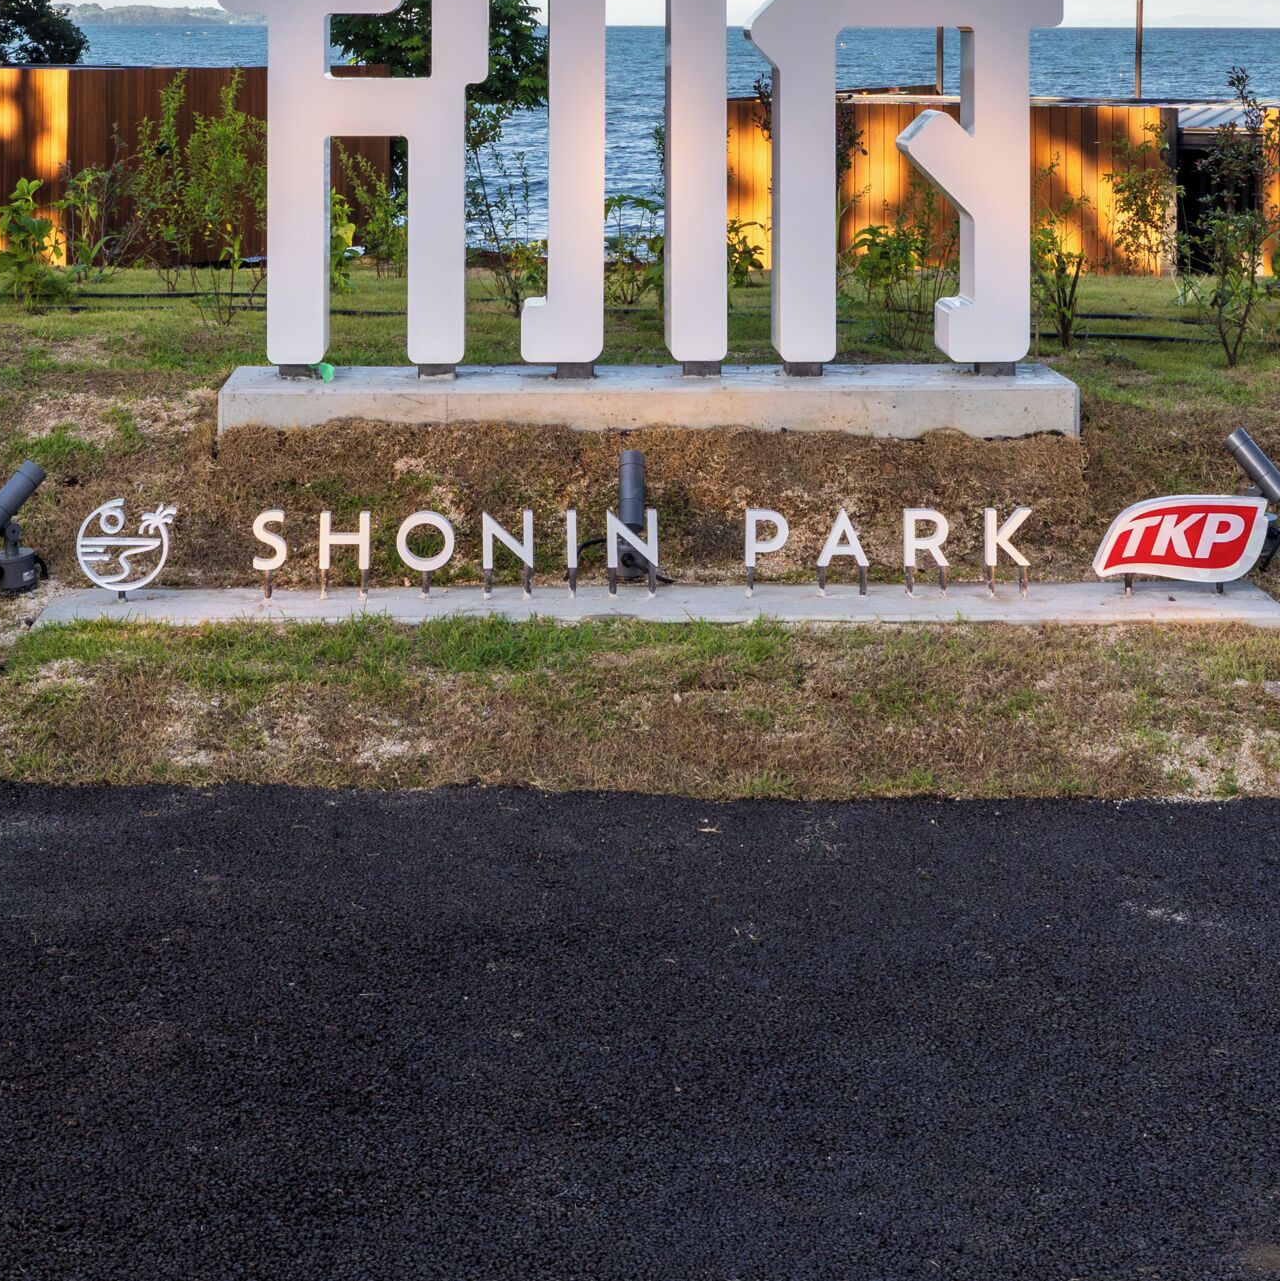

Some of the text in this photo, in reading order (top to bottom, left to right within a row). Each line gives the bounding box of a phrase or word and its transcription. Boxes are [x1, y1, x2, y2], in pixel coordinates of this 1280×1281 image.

[252, 507, 1032, 571] SHONIN PARK
[1121, 513, 1245, 559] TKP
